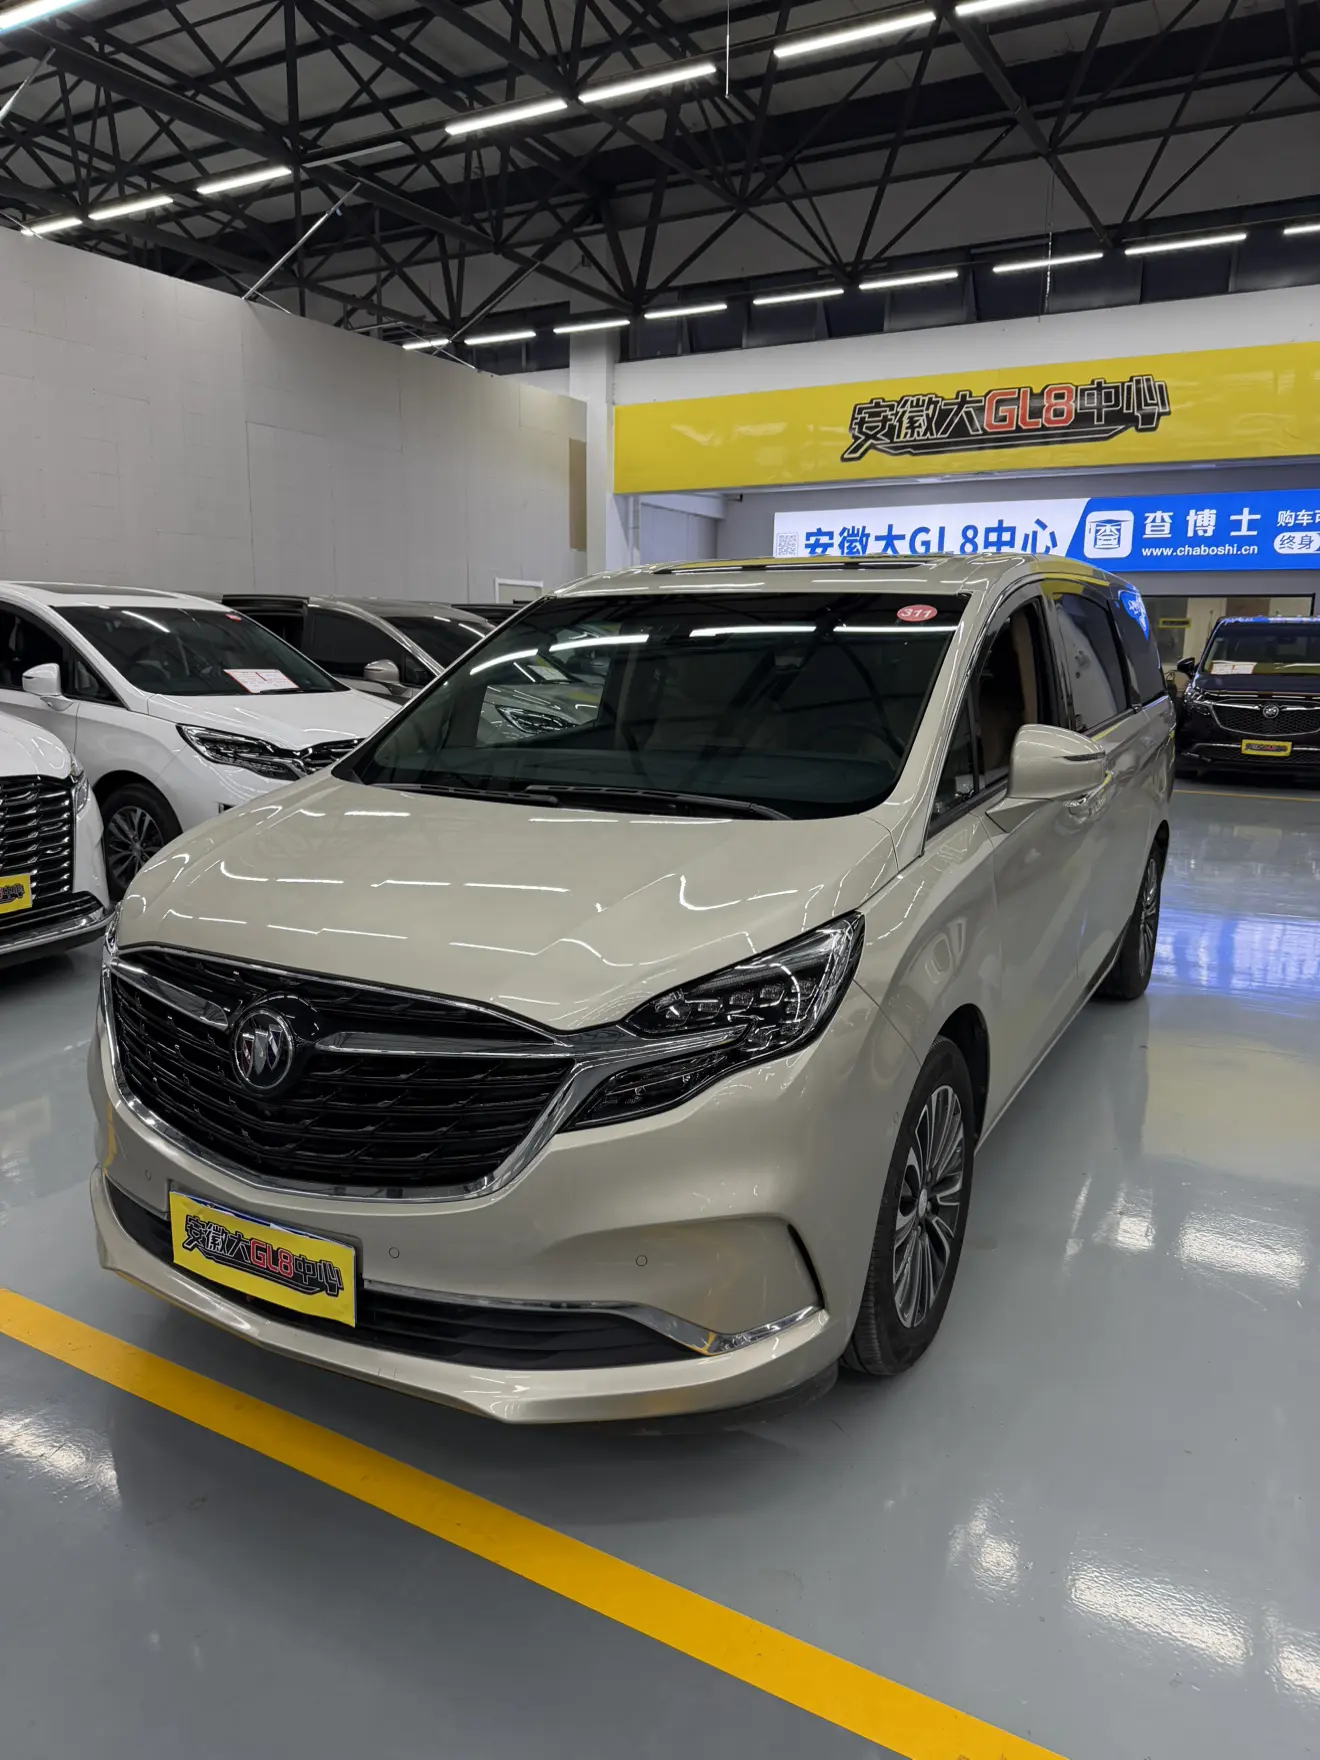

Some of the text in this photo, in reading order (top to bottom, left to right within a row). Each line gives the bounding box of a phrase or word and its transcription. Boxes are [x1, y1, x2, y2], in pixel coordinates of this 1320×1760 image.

[842, 375, 1170, 460] 安徽大GL8中心
[1143, 507, 1261, 538] 查博士
[1276, 509, 1320, 527] 购车
[1142, 543, 1258, 557] www.chaboshi.cn
[183, 1215, 343, 1296] 安徽大GL8中心
